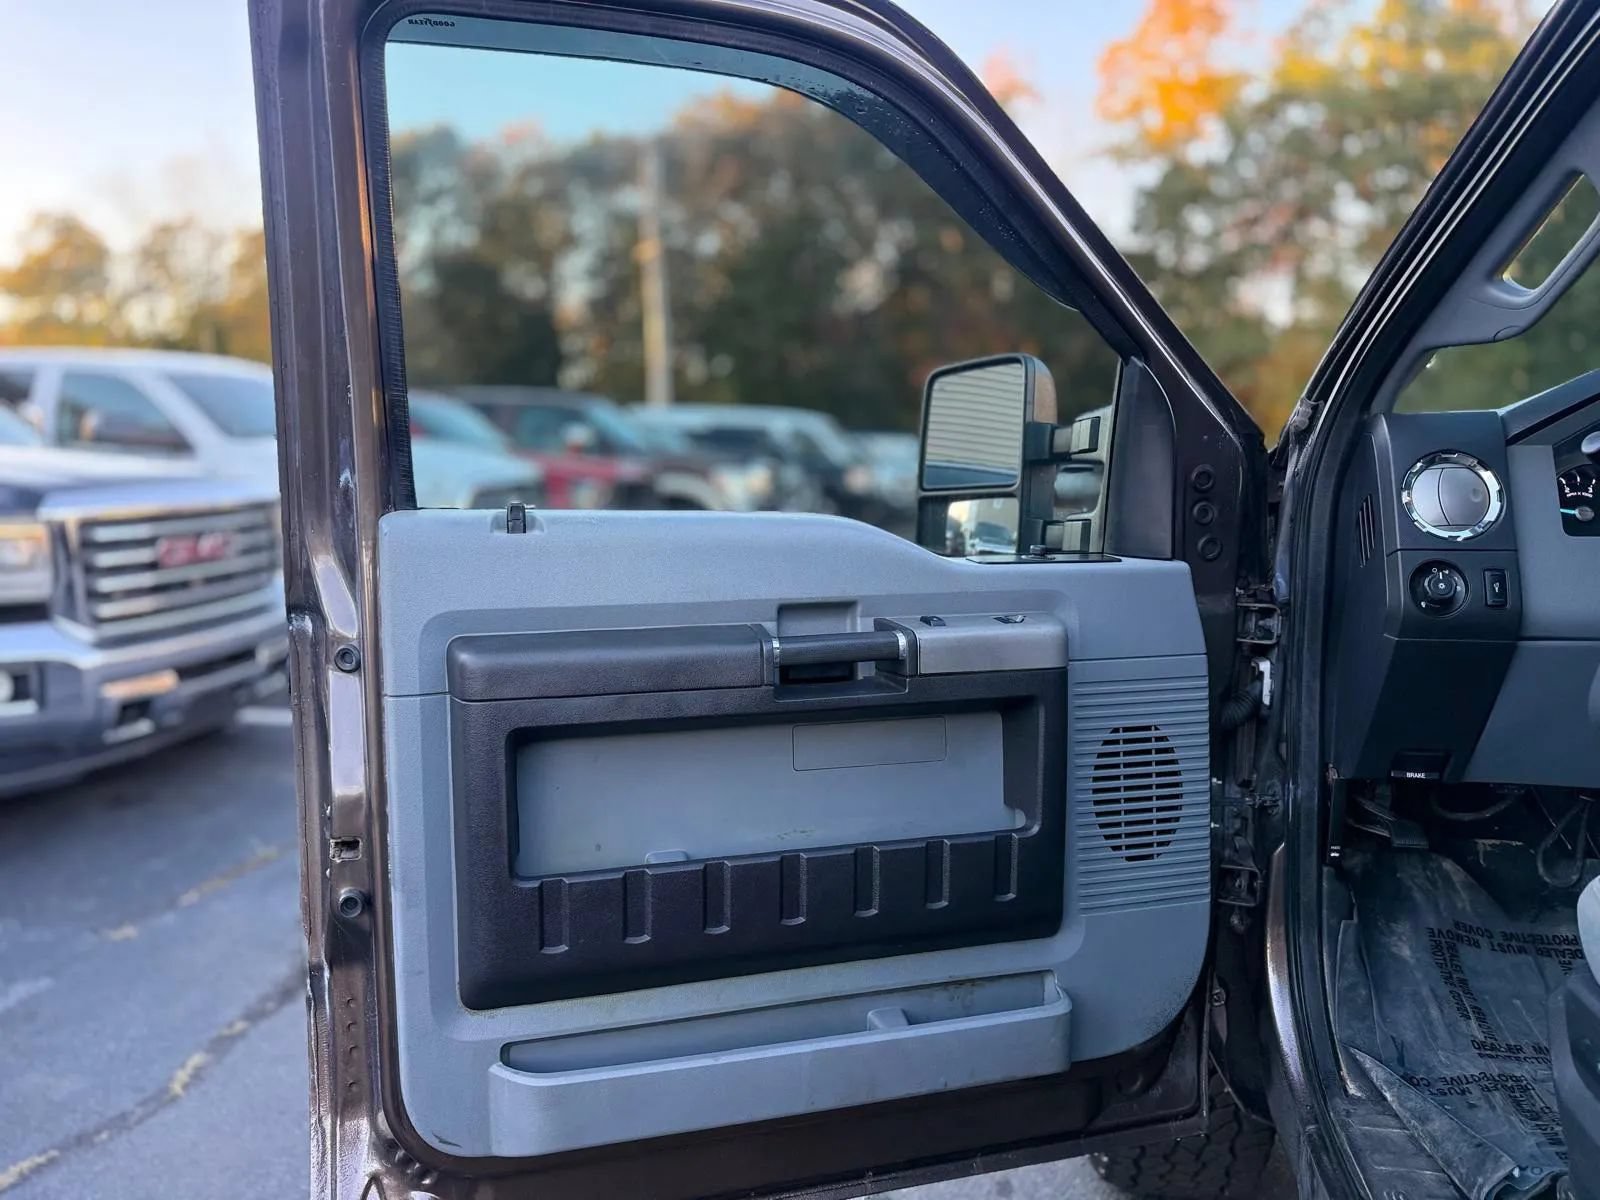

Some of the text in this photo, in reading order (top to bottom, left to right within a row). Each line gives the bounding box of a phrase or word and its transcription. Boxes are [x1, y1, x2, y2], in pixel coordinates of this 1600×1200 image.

[1426, 927, 1585, 960] DEALER MUST REMOVE
[1453, 919, 1579, 947] PROTECTIVE COVER
